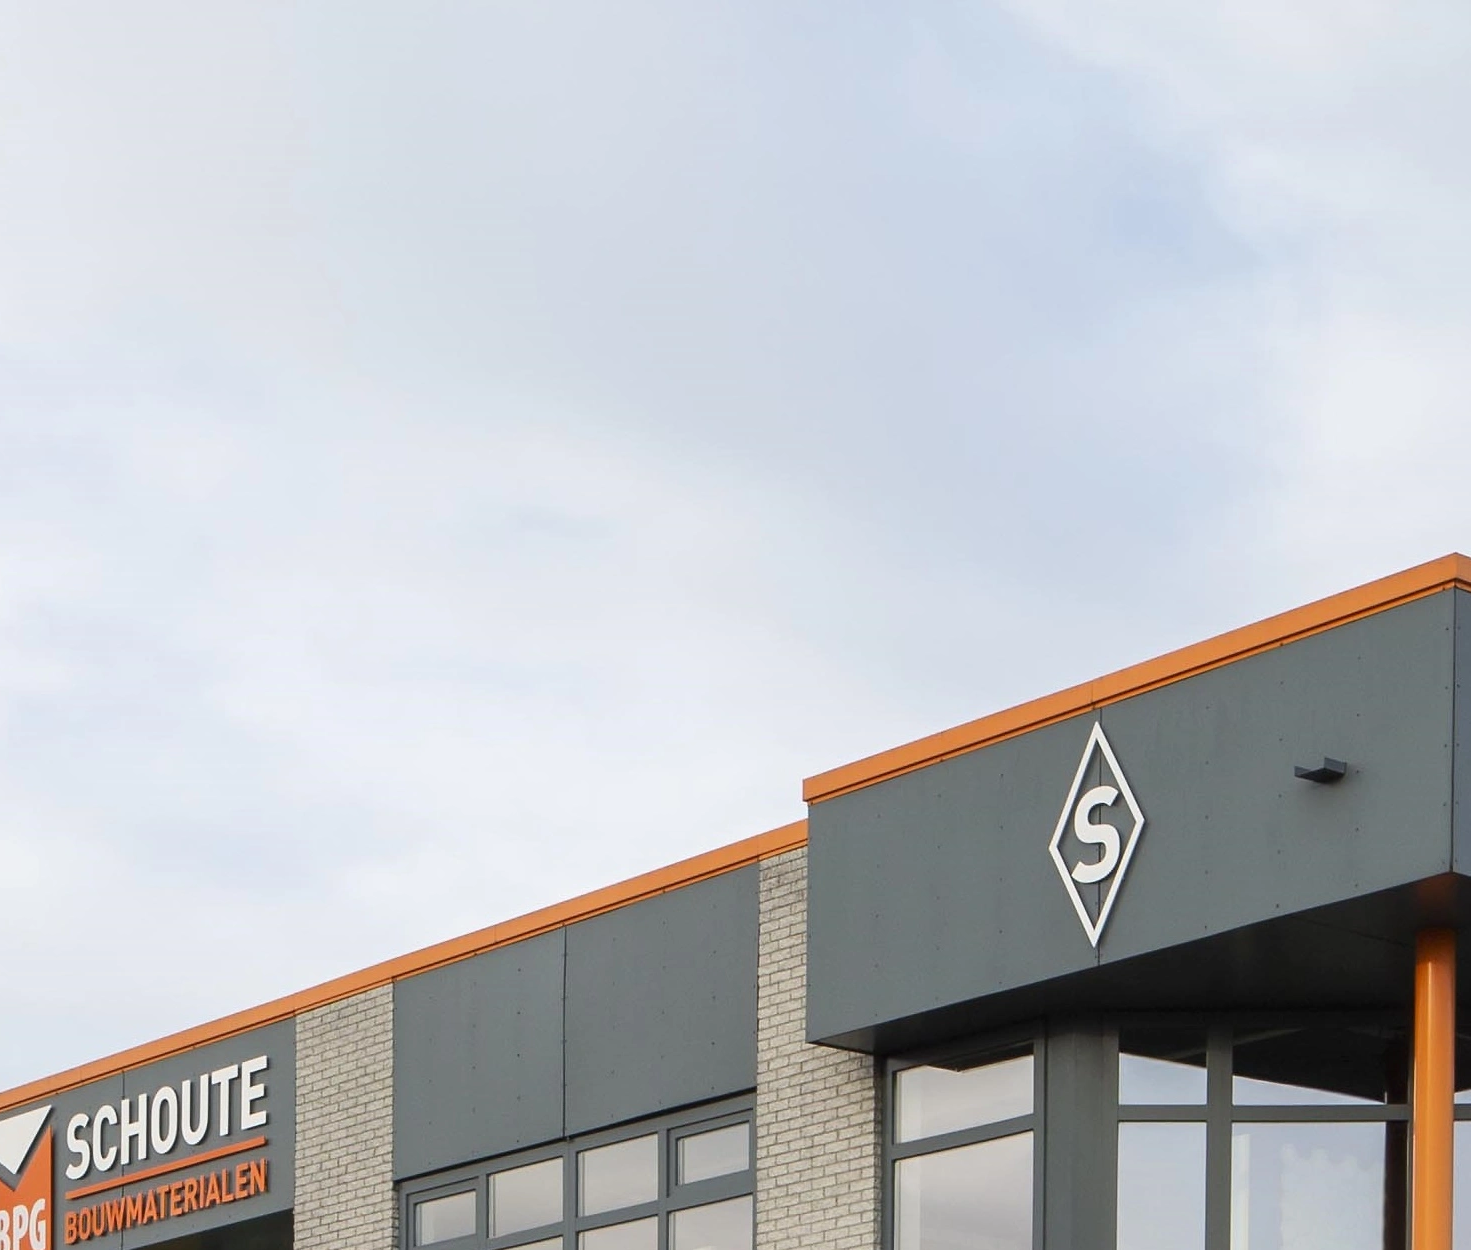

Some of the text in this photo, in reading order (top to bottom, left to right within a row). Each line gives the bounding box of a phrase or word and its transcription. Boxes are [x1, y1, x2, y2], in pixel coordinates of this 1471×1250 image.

[1071, 786, 1120, 884] S
[65, 1055, 268, 1180] SCHOUTE
[65, 1158, 268, 1245] BOUWMATERIALEN
